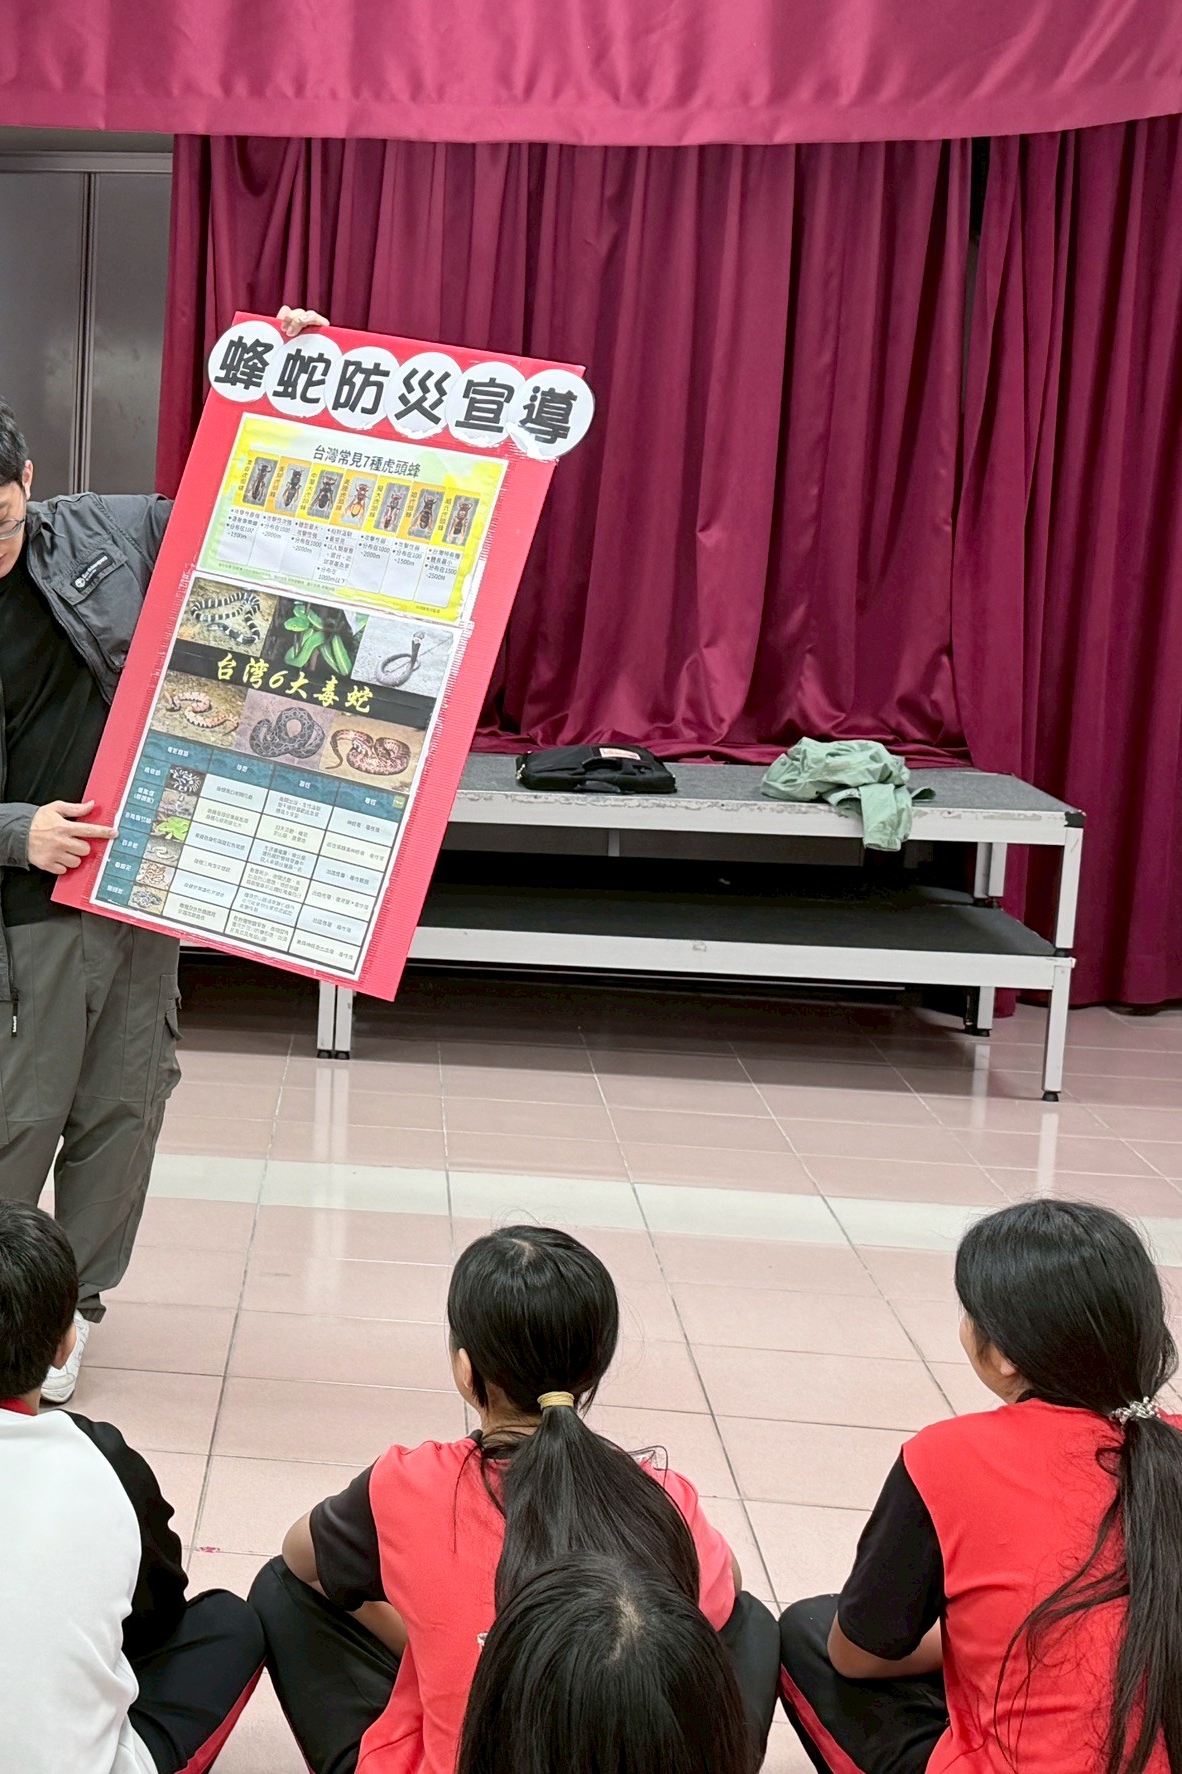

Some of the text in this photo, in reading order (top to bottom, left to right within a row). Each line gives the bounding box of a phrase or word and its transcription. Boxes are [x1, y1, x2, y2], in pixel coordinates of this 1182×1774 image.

[214, 335, 578, 444] 蜂蛇防災宣導
[313, 444, 421, 478] 台灣常見7種虎頭蜂
[216, 652, 374, 713] 台灣6大毒蛇
